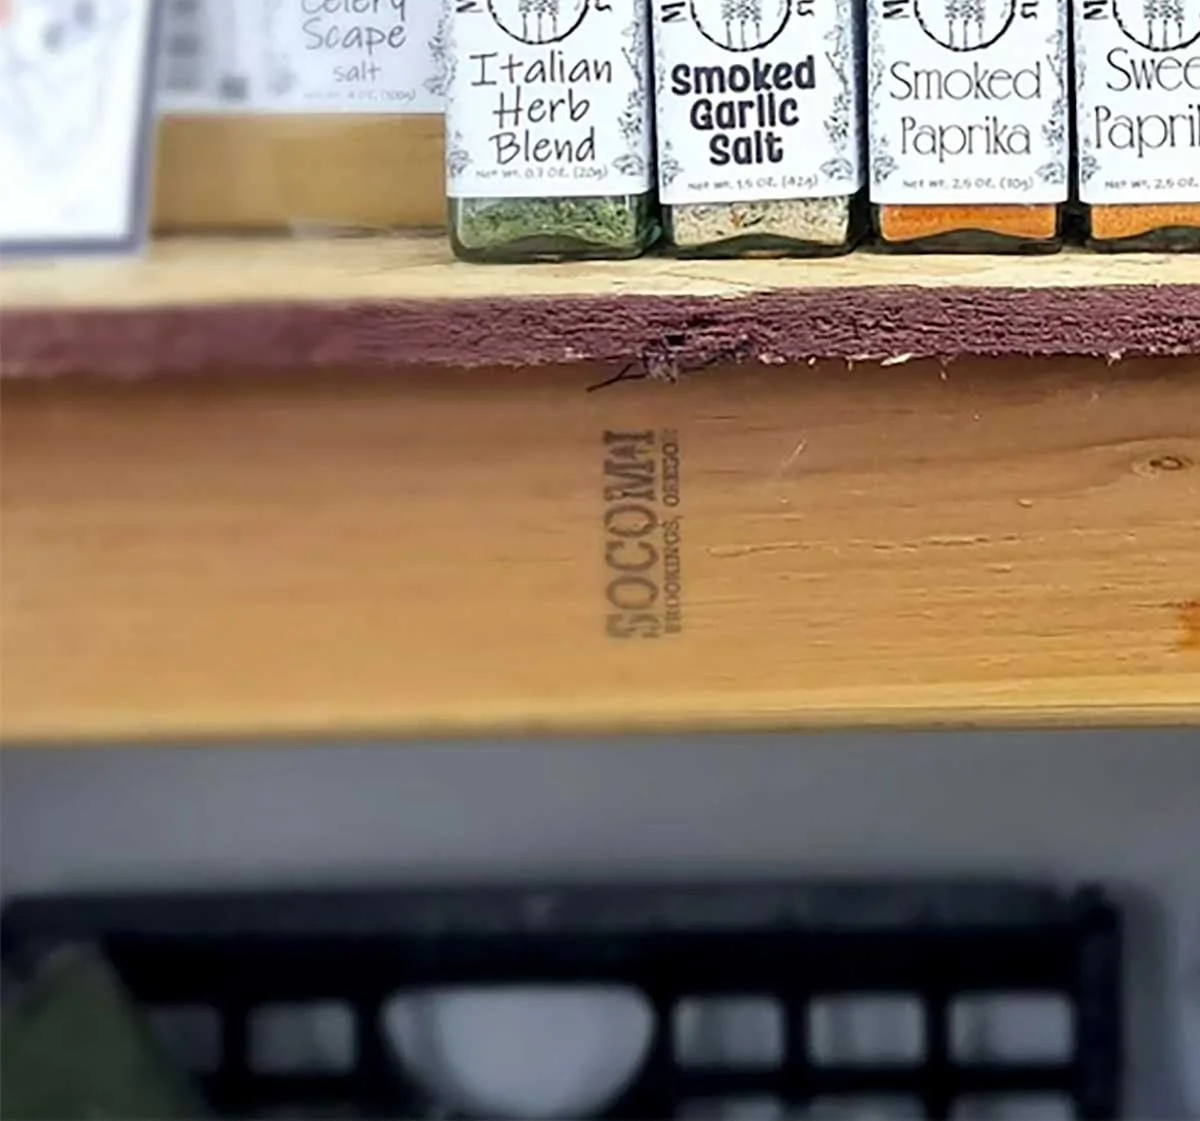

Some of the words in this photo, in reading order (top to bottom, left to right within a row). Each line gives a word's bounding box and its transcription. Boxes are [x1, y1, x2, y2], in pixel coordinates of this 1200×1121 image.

[302, 16, 406, 56] Scape
[332, 59, 382, 82] salt
[469, 49, 612, 87] Italian
[890, 61, 1041, 100] Smoked
[493, 84, 590, 129] Herb
[690, 91, 799, 131] Garlic
[489, 126, 596, 165] Blend
[900, 116, 1031, 163] Paprika
[661, 428, 681, 507] OREGO
